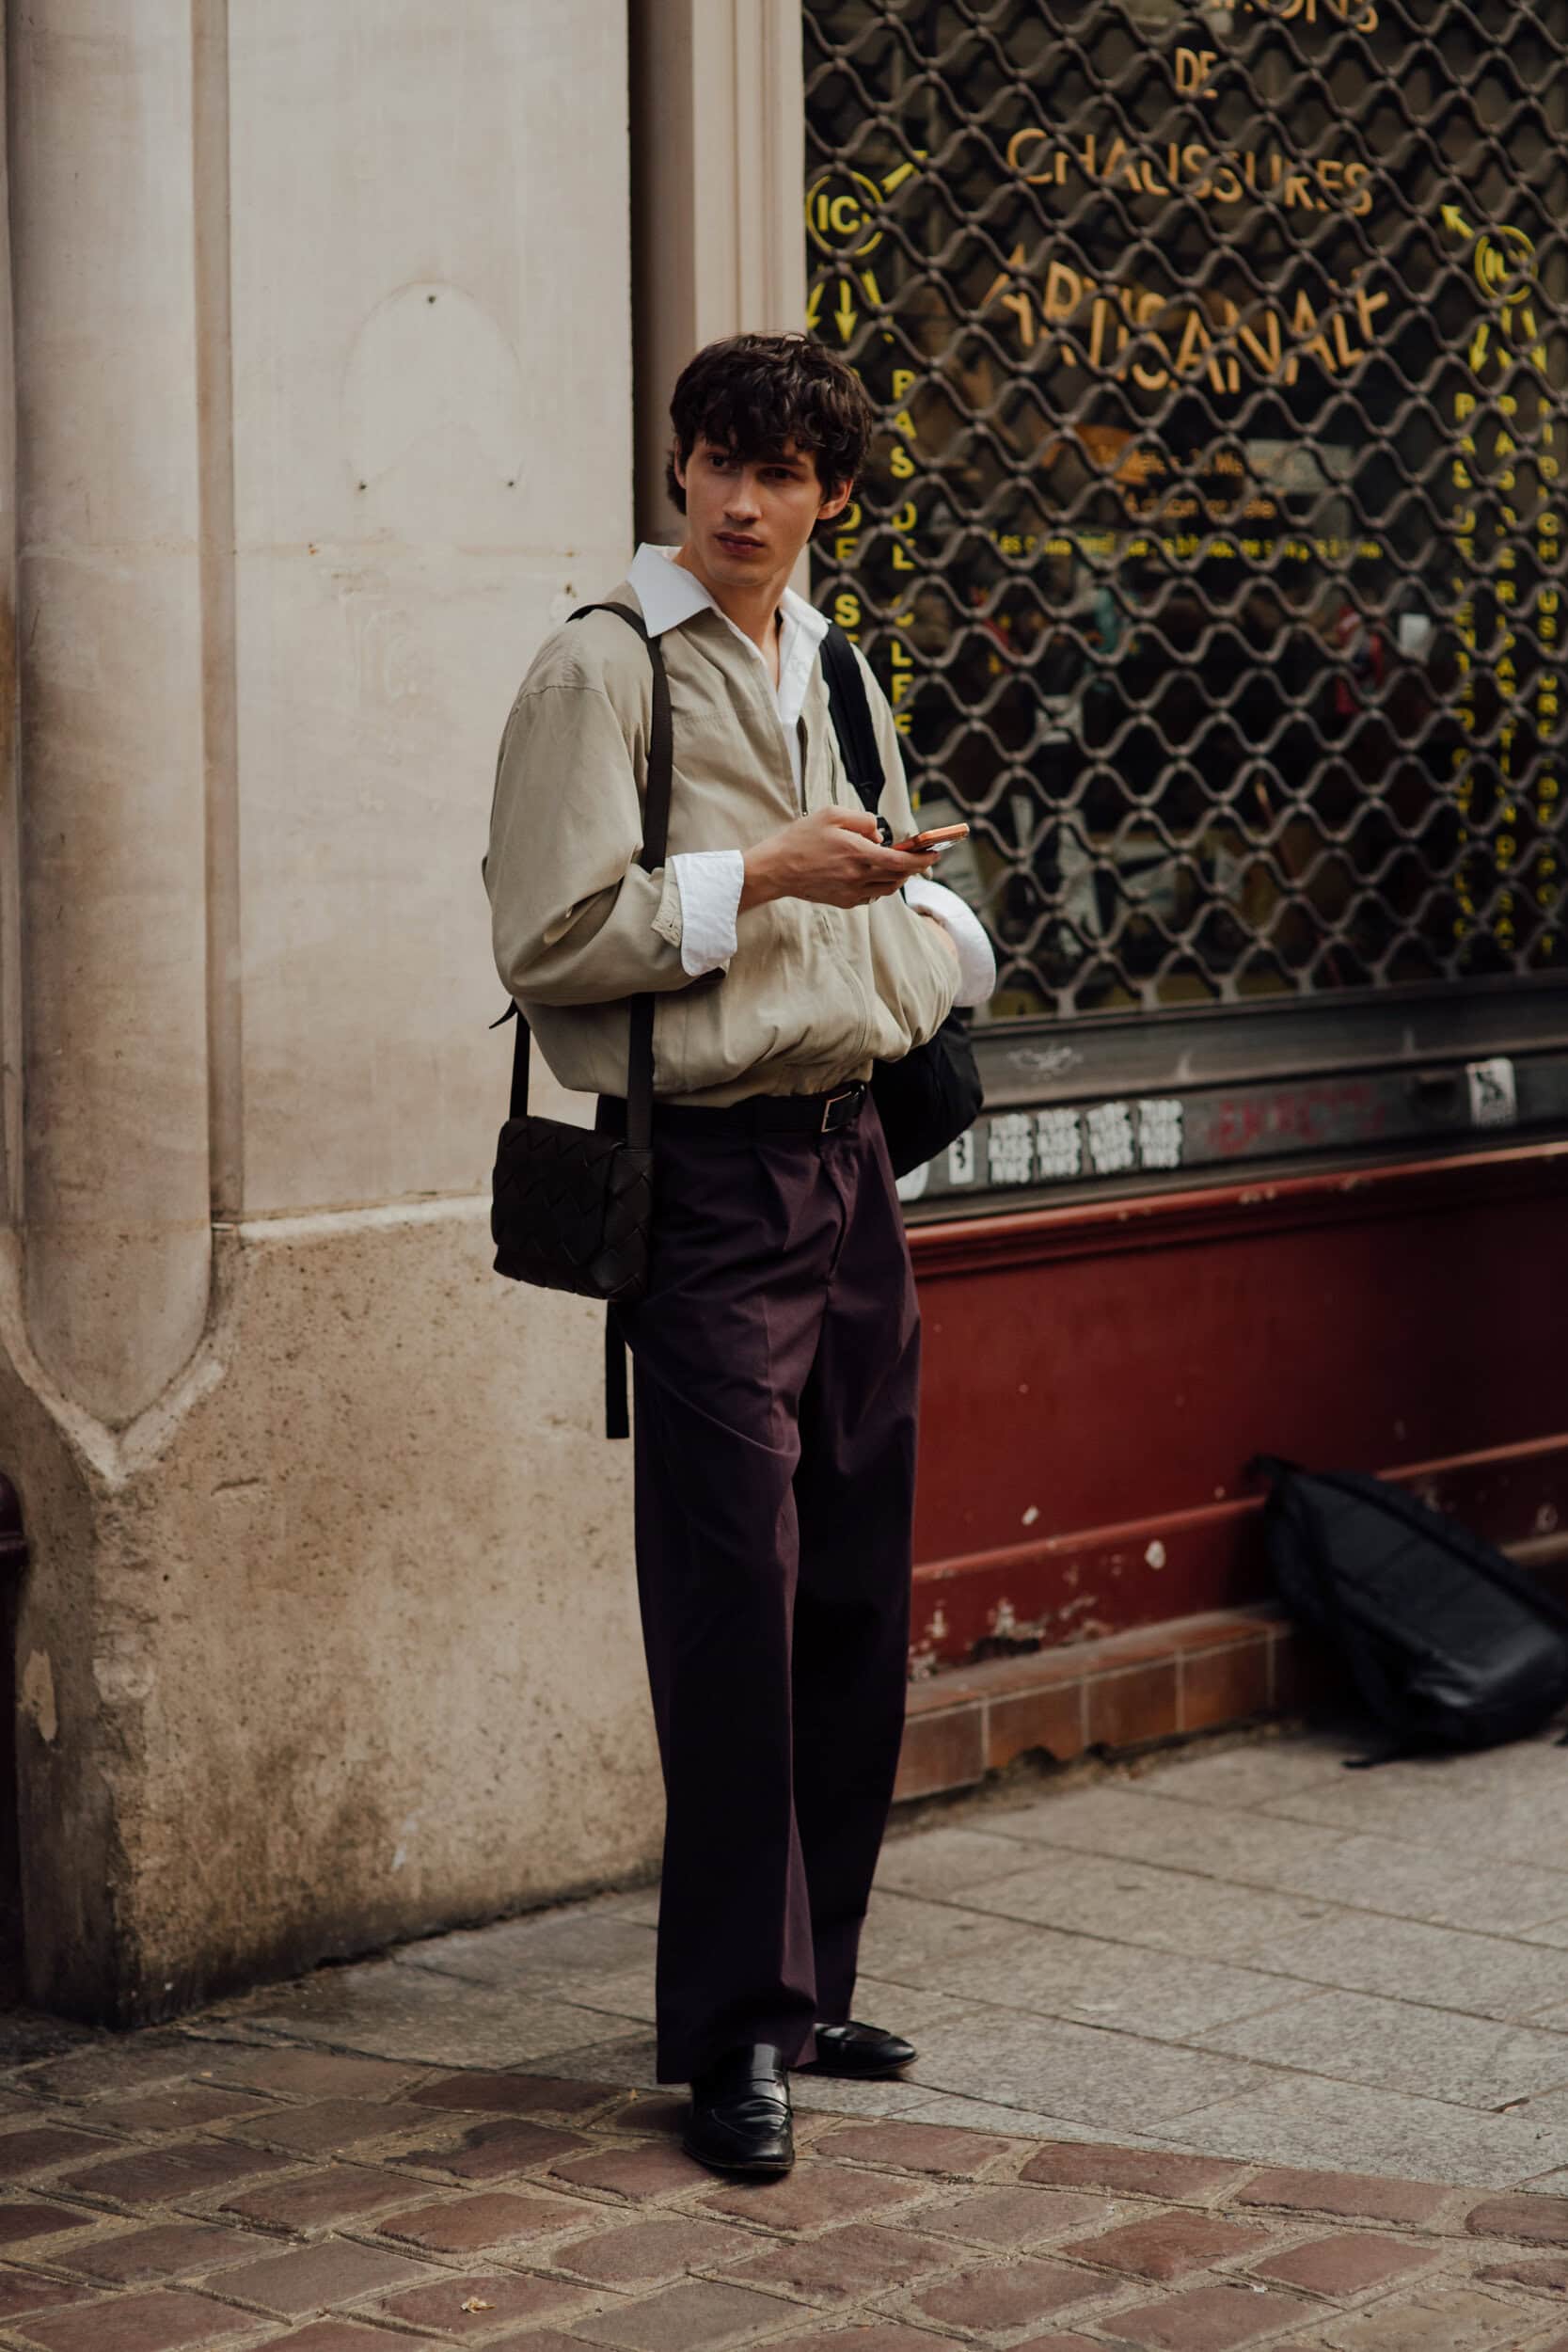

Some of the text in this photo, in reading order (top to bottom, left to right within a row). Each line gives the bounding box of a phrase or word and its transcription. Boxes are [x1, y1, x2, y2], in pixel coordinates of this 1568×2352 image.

[1175, 47, 1219, 100] DE
[1006, 127, 1373, 217] CHAUSSURES
[816, 193, 872, 234] IC
